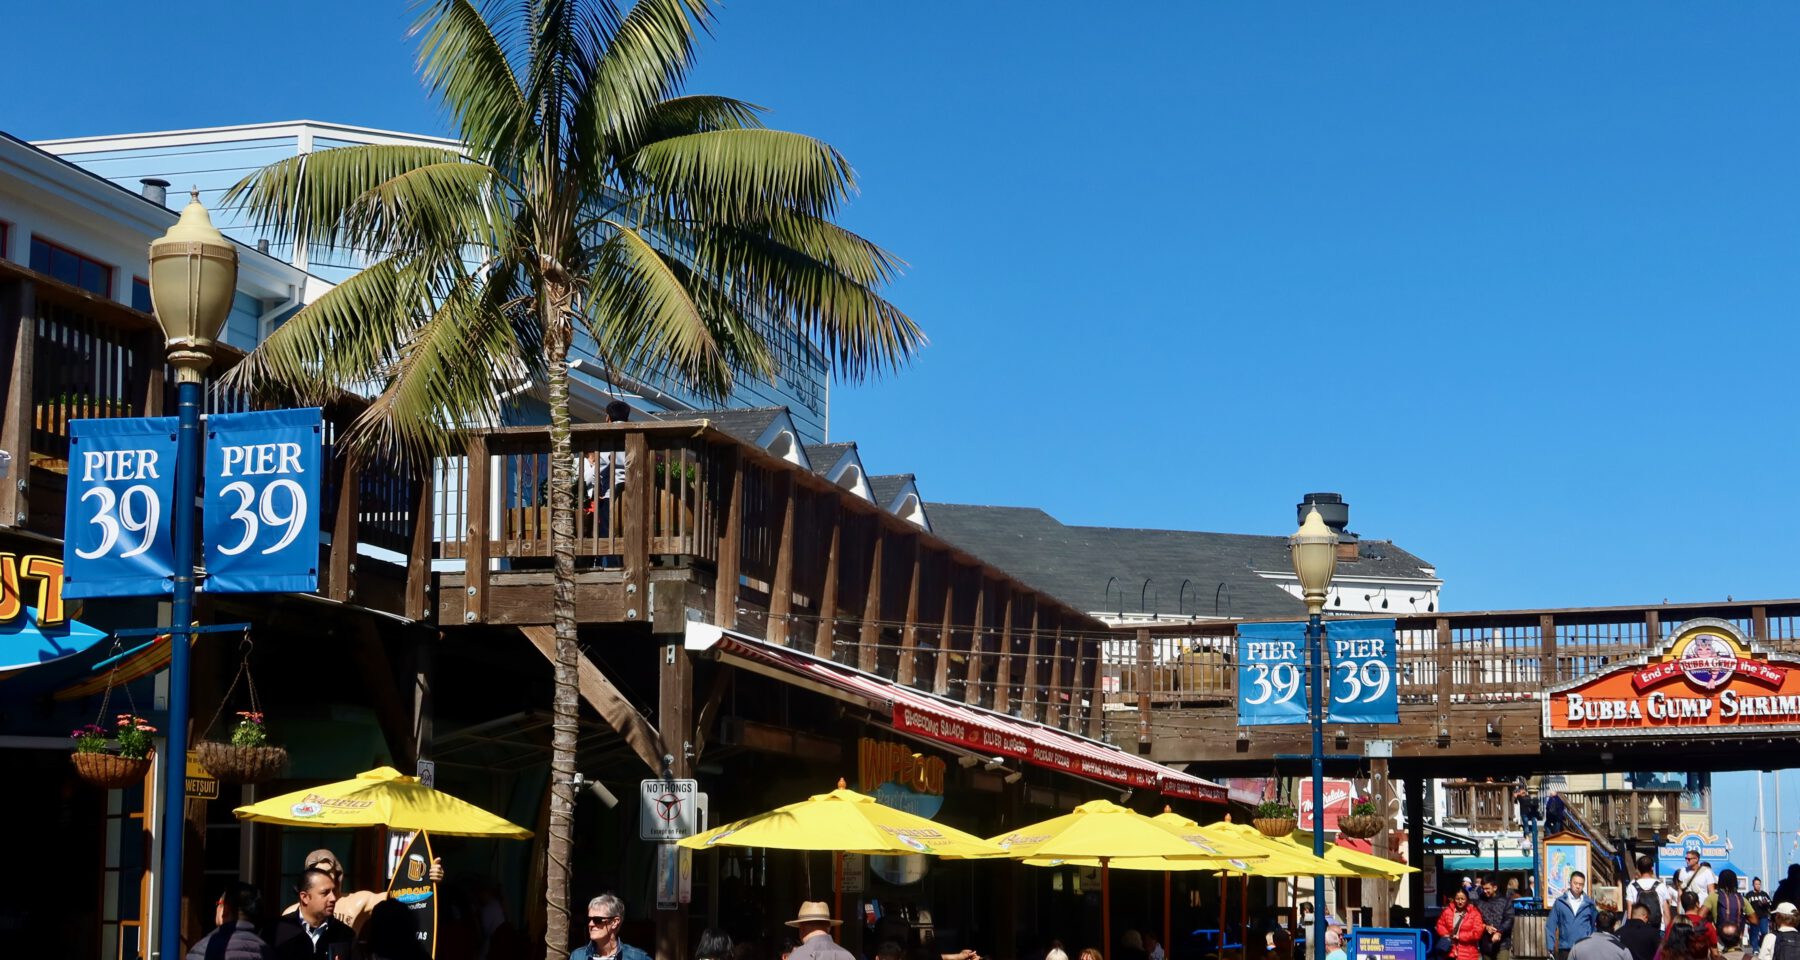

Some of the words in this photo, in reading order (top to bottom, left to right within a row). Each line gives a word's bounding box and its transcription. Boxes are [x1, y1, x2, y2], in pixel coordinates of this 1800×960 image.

[82, 449, 160, 482] PIER
[220, 442, 305, 477] PIER
[74, 484, 160, 560] 39
[217, 478, 308, 556] 39
[1247, 641, 1298, 660] PIER
[1335, 638, 1387, 659] PIER
[1640, 668, 1661, 683] End
[1664, 662, 1674, 674] of
[1740, 661, 1757, 673] the
[1760, 666, 1781, 681] Pier
[1682, 659, 1709, 669] BUBBA
[1711, 658, 1735, 668] GUMP
[1245, 662, 1300, 705] 39
[1334, 659, 1390, 704] 39
[1566, 693, 1642, 721] BUBBA
[1647, 691, 1712, 719] GUMP
[1720, 690, 1800, 718] SHRIM
[904, 709, 939, 736] SHREDDING
[941, 719, 965, 740] SALADS
[984, 730, 1002, 747] KILLER
[1004, 738, 1028, 754] BURGERS
[858, 737, 946, 796] WIPEOUT
[186, 779, 216, 794] WETSUIT
[647, 784, 658, 793] NO
[660, 784, 692, 793] THONGS
[1323, 788, 1347, 805] ields
[1660, 847, 1684, 857] BOAT
[408, 901, 427, 910] outbar
[416, 931, 428, 941] AS
